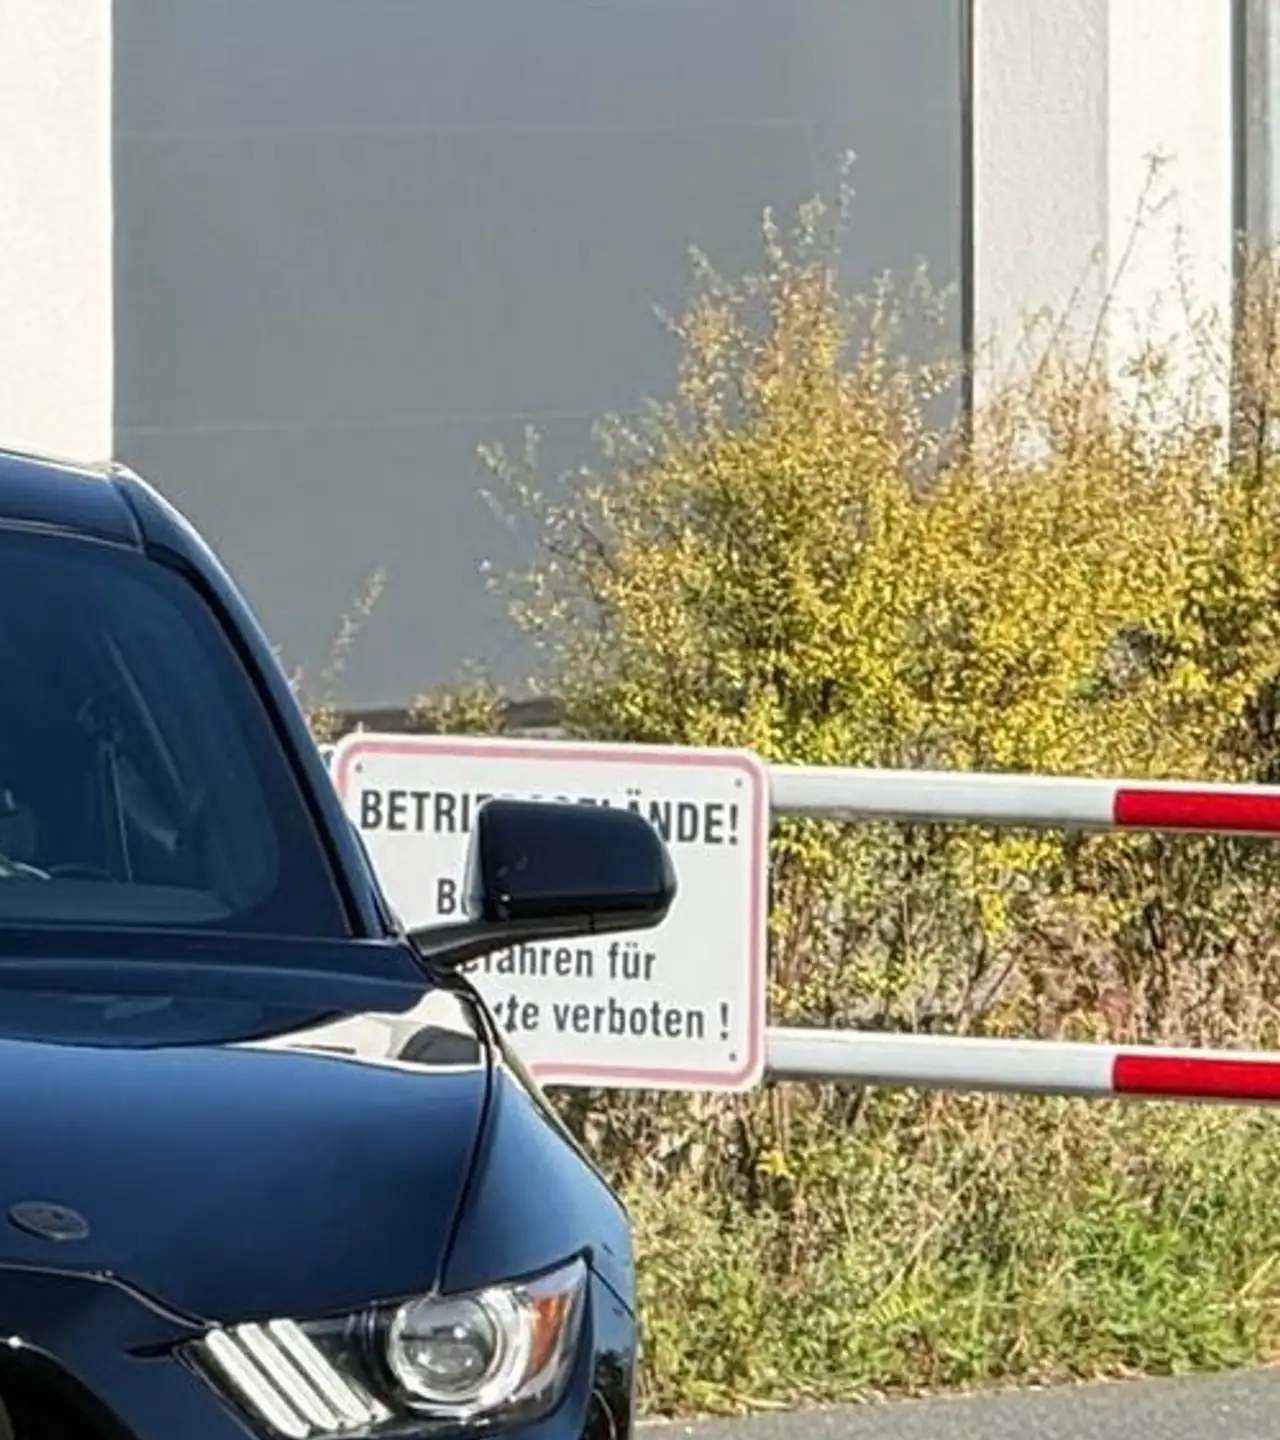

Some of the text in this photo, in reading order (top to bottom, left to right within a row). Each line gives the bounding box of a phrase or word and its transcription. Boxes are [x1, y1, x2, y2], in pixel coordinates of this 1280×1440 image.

[359, 788, 739, 846] BETRINDE!
[608, 941, 657, 980] für
[552, 1001, 705, 1038] verboten
